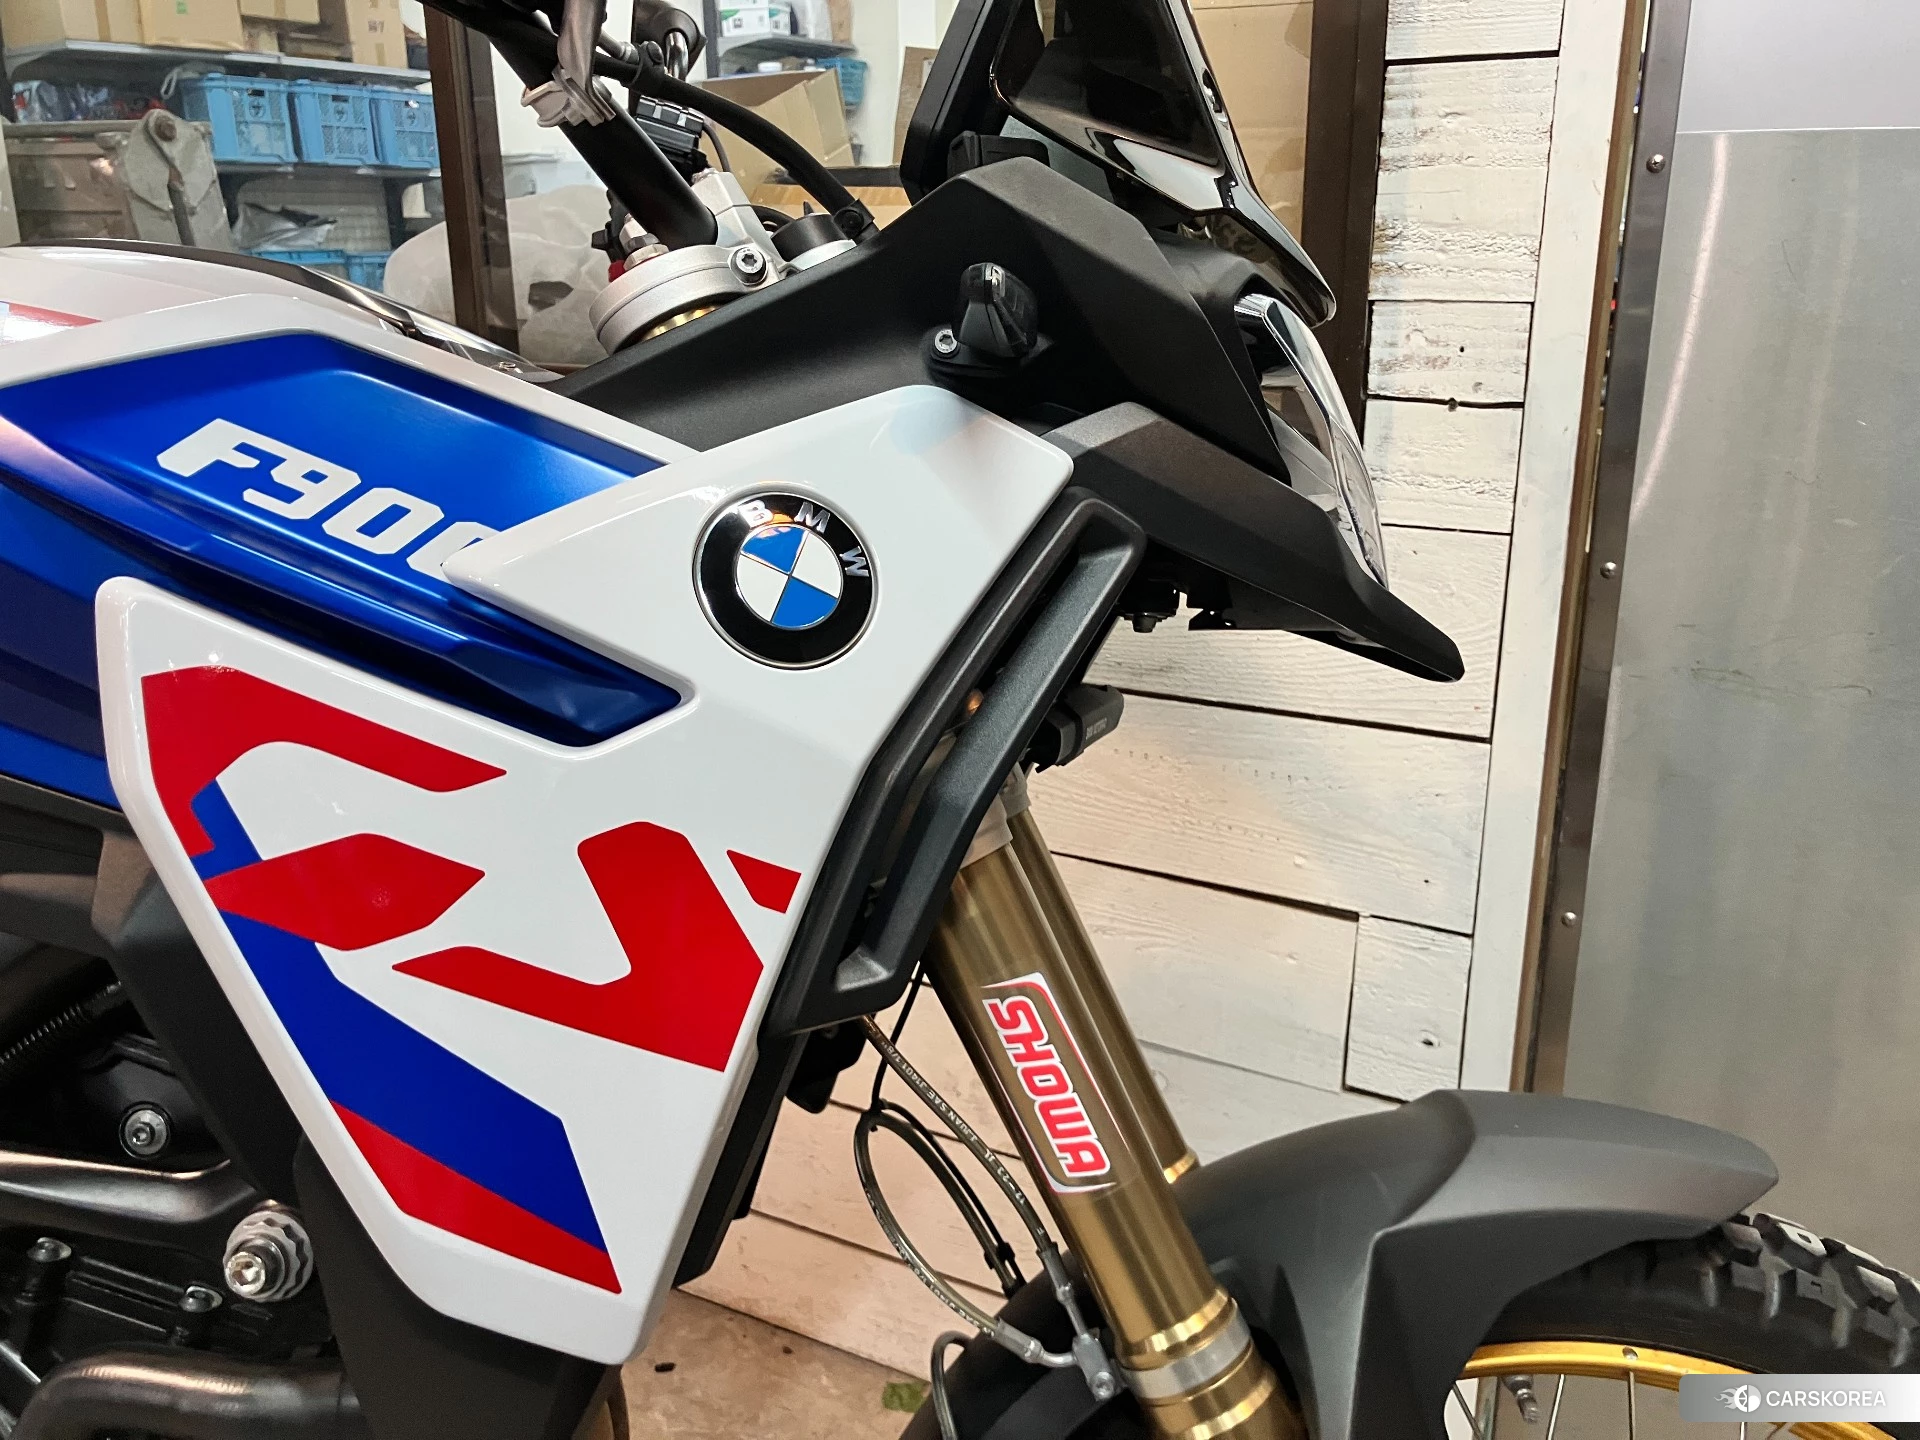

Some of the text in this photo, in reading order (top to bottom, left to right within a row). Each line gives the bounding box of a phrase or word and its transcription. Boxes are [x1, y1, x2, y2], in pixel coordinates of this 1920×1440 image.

[737, 500, 870, 577] BMW
[926, 1090, 948, 1112] SAE
[982, 994, 1111, 1178] SHOWA
